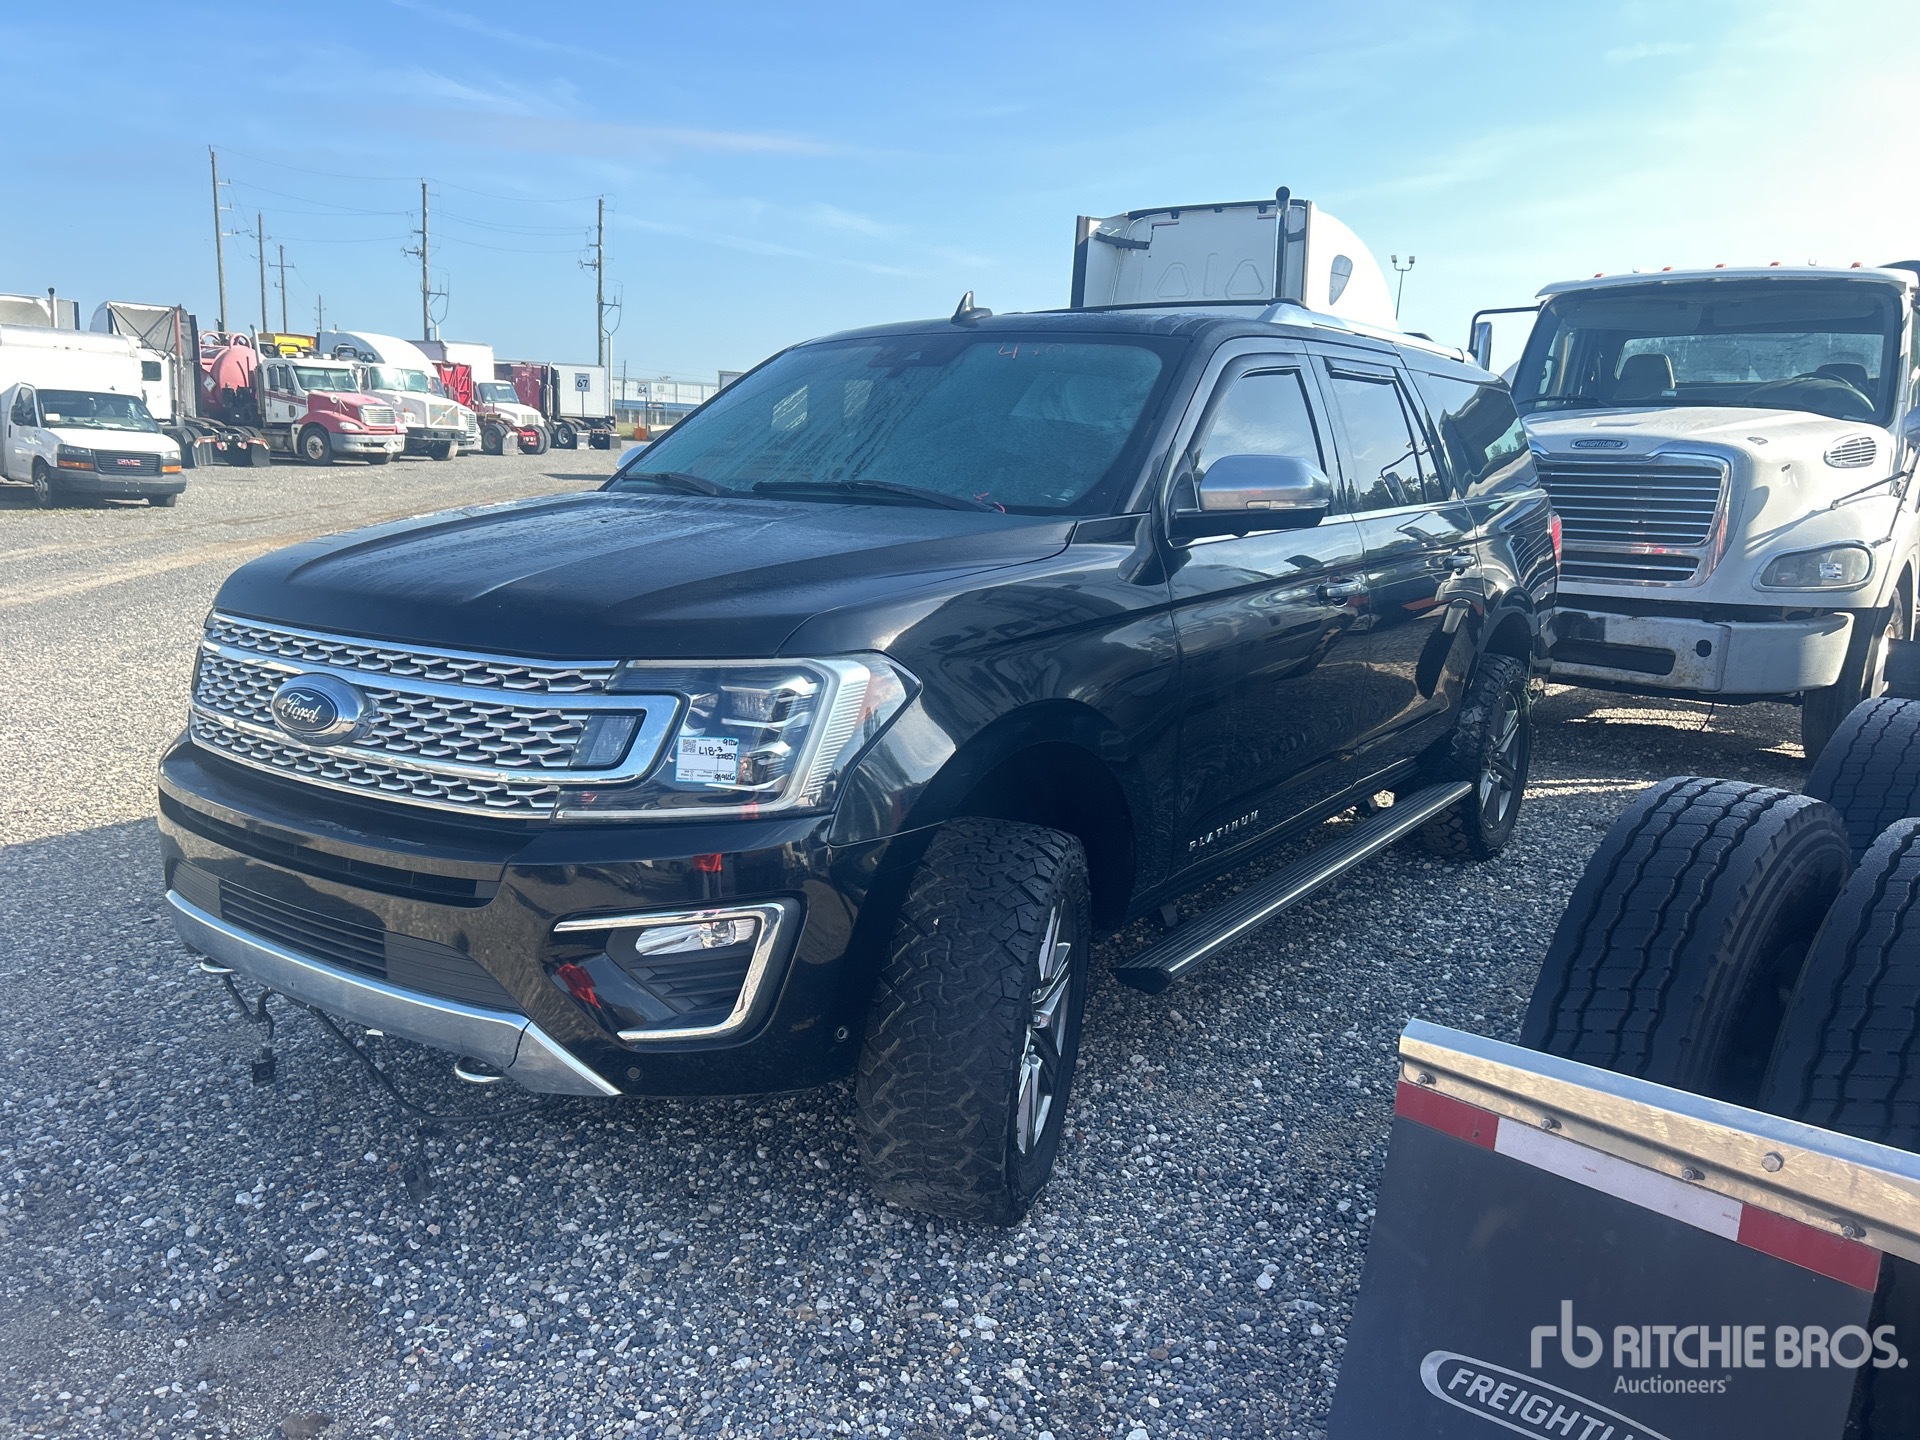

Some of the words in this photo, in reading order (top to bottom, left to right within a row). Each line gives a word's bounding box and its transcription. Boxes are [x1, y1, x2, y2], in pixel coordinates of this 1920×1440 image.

[576, 379, 589, 388] 67
[637, 386, 648, 394] 64
[116, 458, 141, 466] GMC
[281, 692, 322, 723] Ford
[1188, 809, 1259, 852] PLATINUM
[1447, 1367, 1634, 1440] FREIGHT
